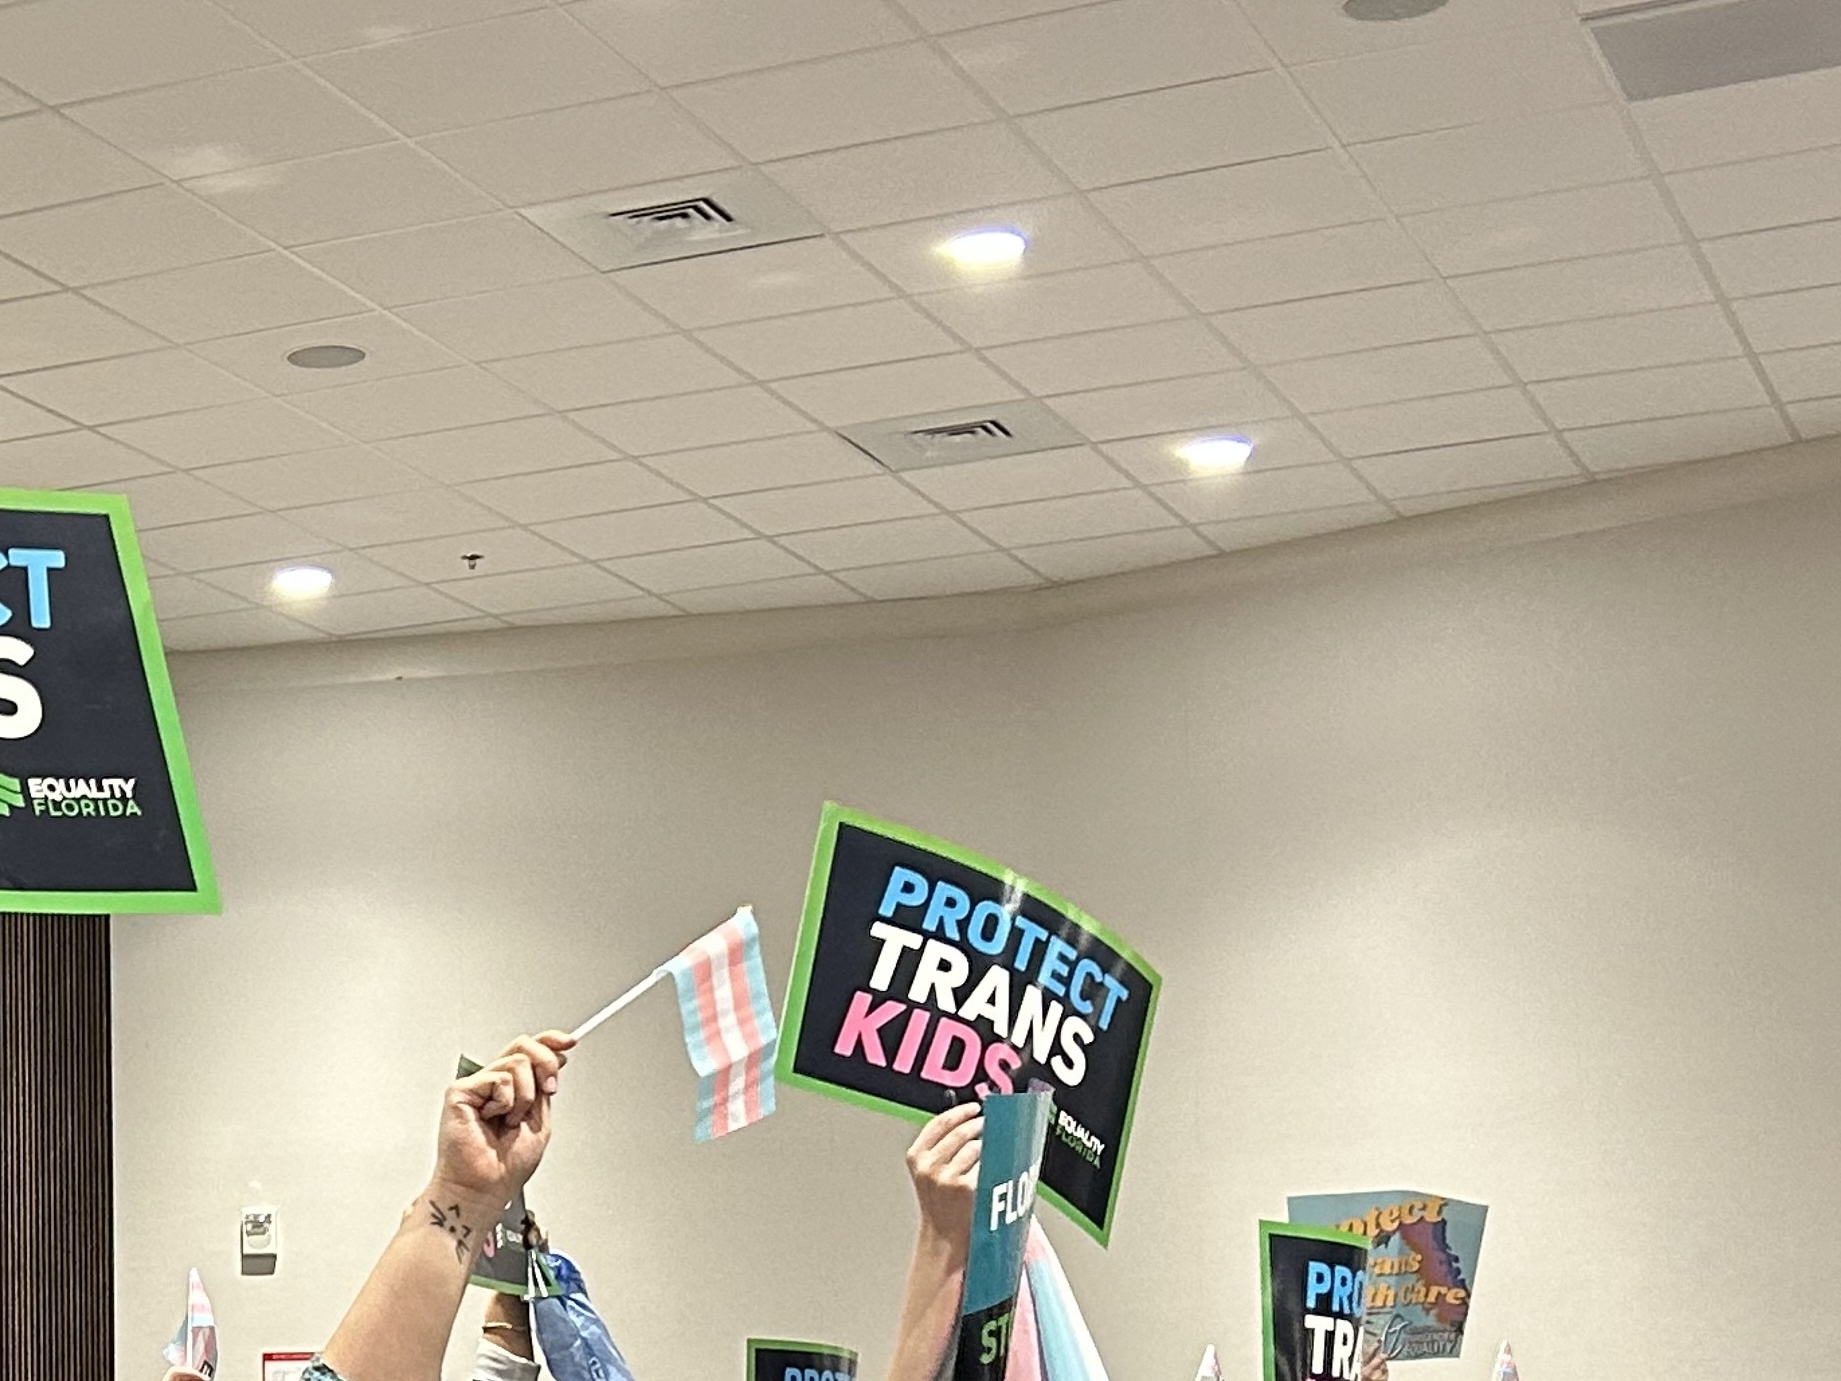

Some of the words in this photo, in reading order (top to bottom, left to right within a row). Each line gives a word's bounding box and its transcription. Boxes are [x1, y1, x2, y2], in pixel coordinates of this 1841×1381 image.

[28, 775, 136, 802] EQUALITY
[31, 797, 142, 819] FLORIDA
[878, 865, 1130, 1032] PROTECT
[869, 921, 1096, 1088] TRANS
[833, 990, 1021, 1097] KIDS
[1056, 1125, 1101, 1170] FLORIDA
[1058, 1110, 1105, 1156] EQUALITY
[979, 1312, 1013, 1365] ST
